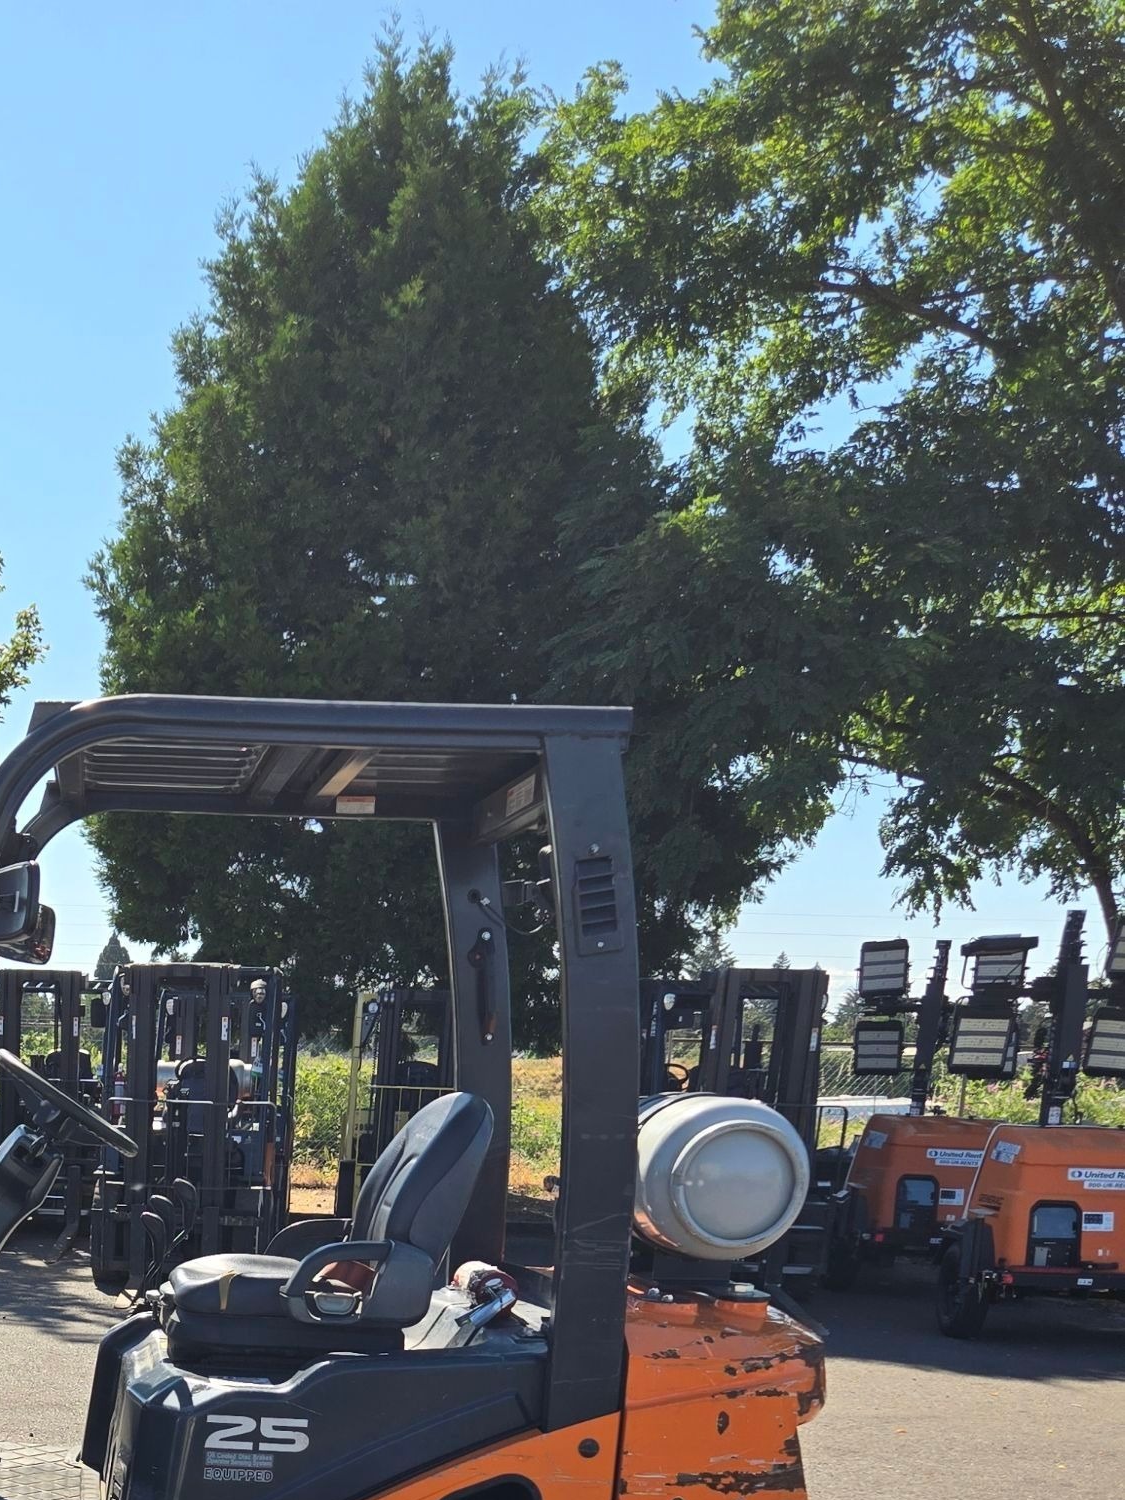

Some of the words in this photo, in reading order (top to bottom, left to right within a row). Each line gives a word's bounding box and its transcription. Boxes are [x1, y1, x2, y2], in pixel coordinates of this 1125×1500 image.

[965, 1151, 983, 1159] Rent
[1084, 1170, 1116, 1179] United
[204, 1414, 310, 1453] 25
[204, 1467, 274, 1482] EQUIPPED
